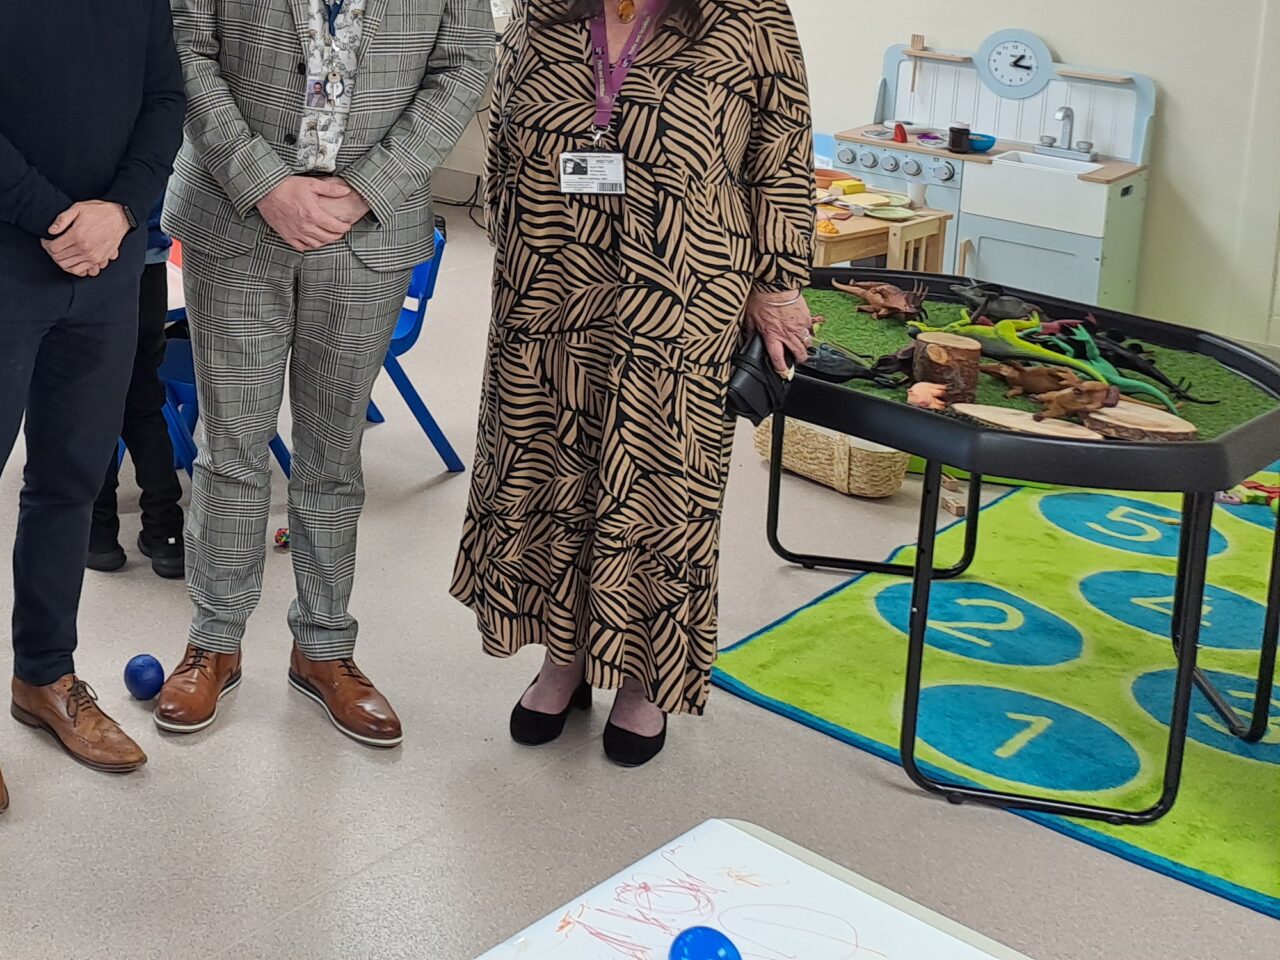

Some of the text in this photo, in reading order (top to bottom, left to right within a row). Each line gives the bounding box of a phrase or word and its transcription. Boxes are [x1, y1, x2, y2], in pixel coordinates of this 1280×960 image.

[1087, 506, 1181, 542] 5
[926, 598, 1024, 647] 2
[994, 712, 1054, 759] 1
